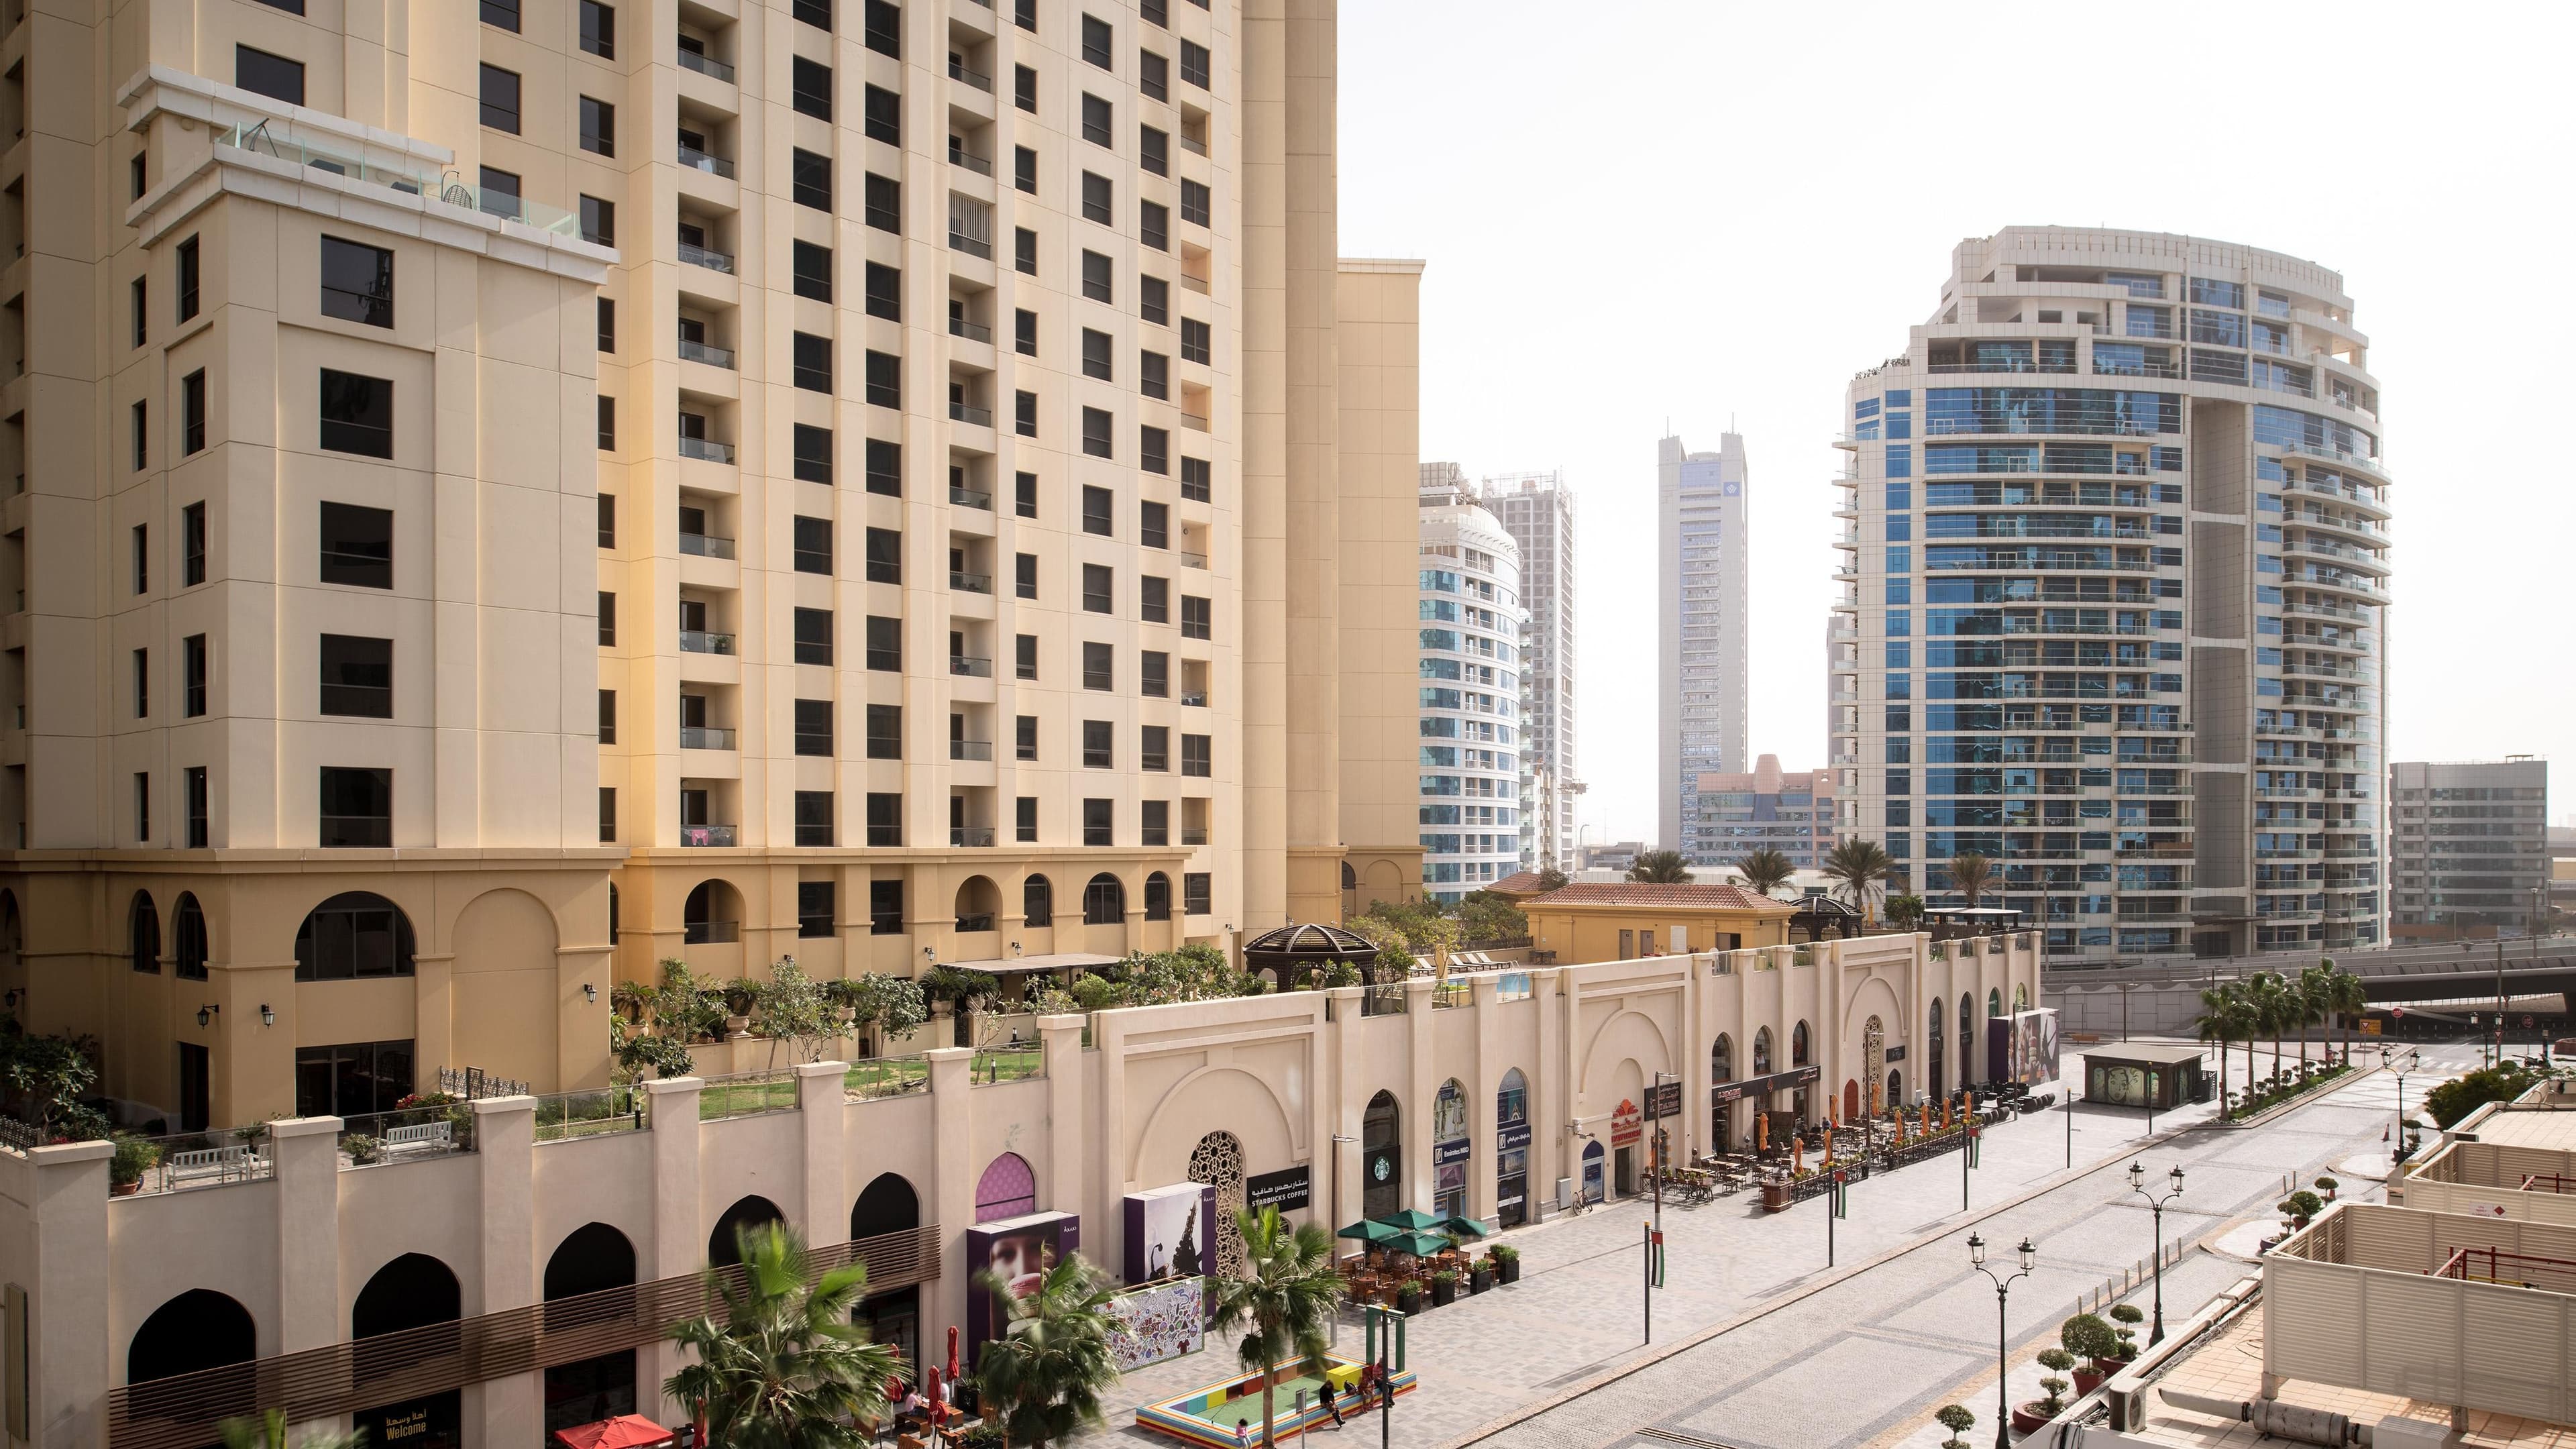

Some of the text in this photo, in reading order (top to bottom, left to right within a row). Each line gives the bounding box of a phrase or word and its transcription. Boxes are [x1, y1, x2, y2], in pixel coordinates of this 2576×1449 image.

[1444, 1149, 1460, 1157] Emirates
[1251, 1189, 1308, 1208] STARBUCKS COFFEE
[386, 1421, 427, 1441] Welcome
